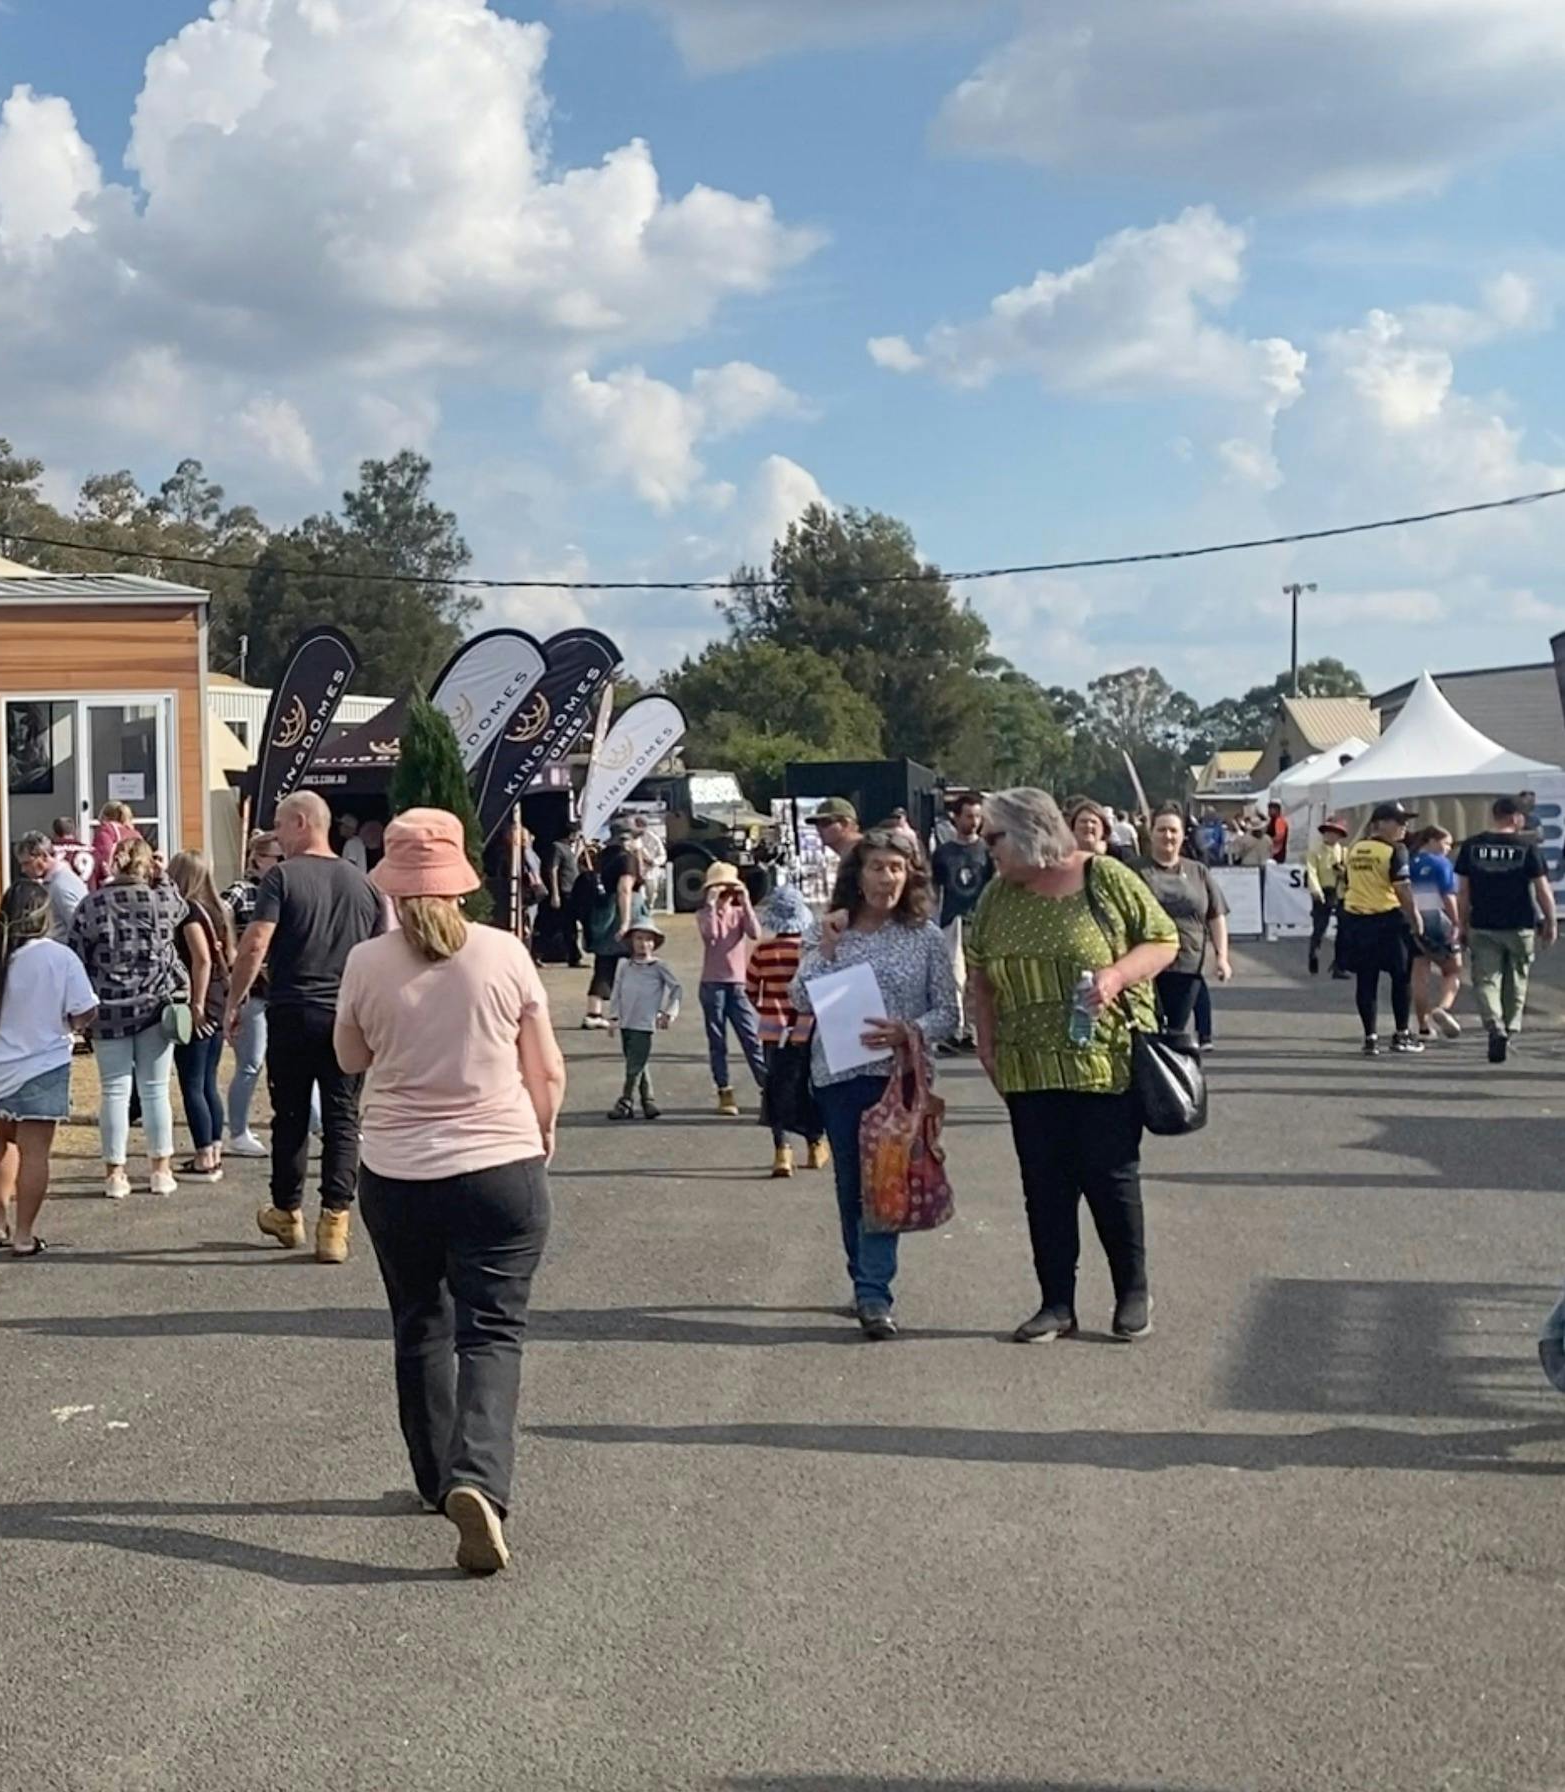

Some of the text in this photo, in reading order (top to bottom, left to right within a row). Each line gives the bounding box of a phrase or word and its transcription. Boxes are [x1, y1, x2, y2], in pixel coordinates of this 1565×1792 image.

[274, 669, 345, 803] KINGDOMES
[504, 667, 601, 796] KINGDOMES
[597, 727, 673, 811] KINGDOMES
